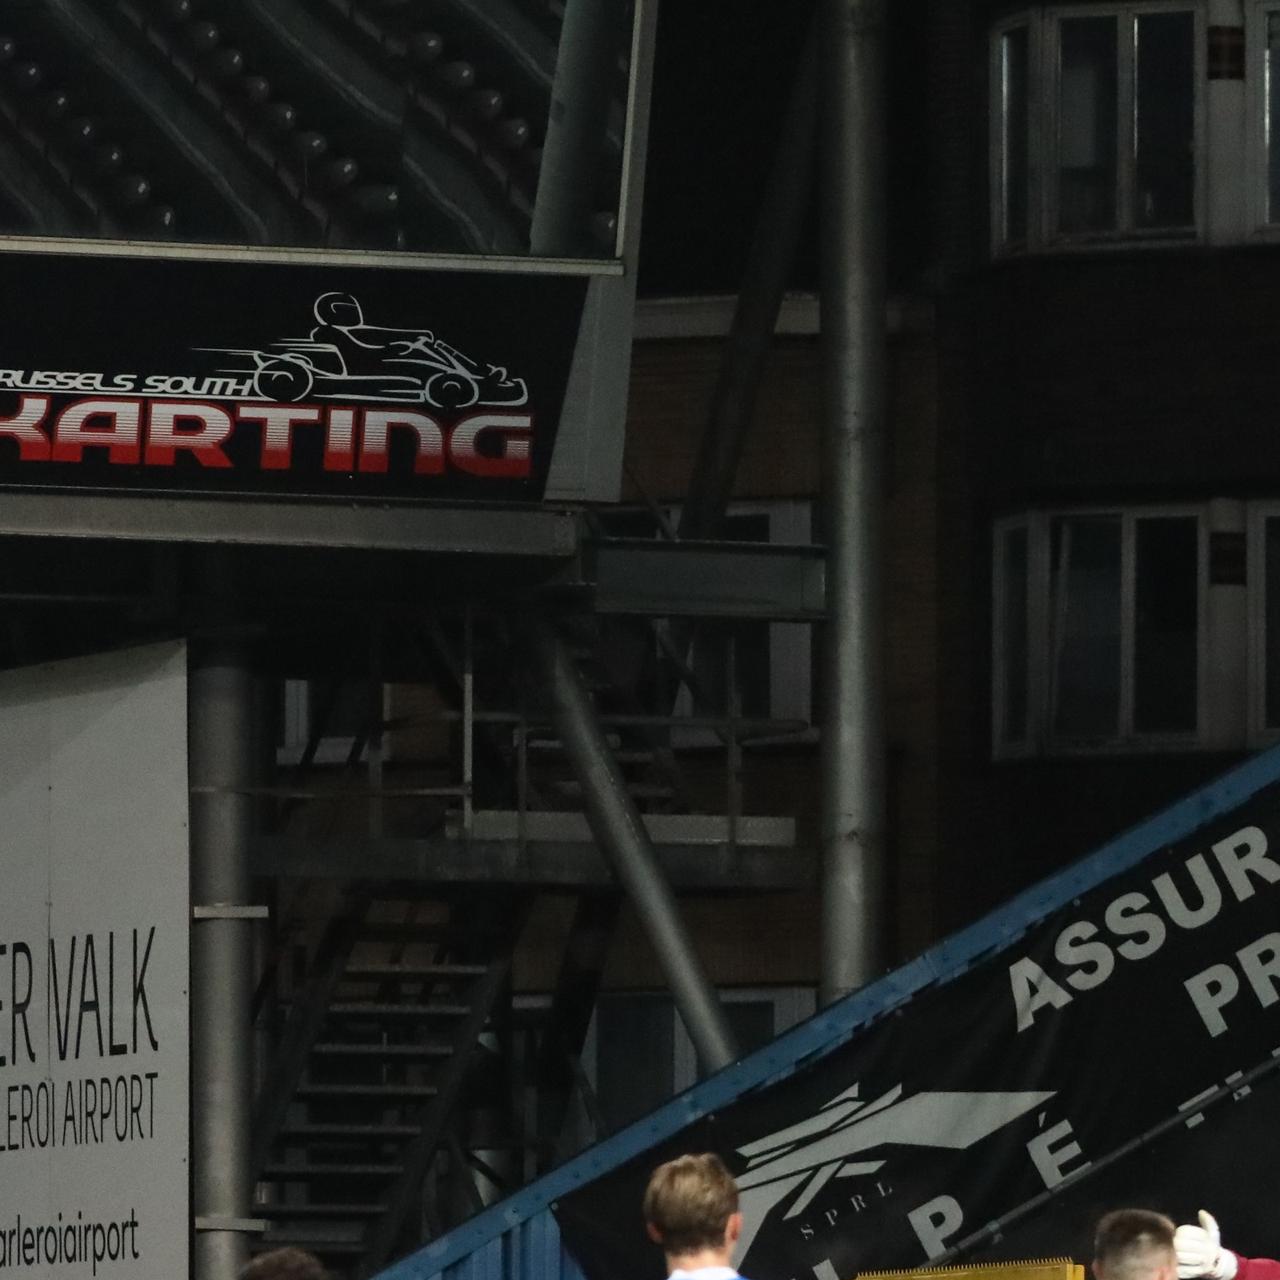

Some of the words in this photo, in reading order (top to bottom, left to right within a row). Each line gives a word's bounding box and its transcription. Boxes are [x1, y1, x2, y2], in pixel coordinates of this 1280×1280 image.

[142, 376, 254, 396] SOUTH
[50, 926, 159, 1061] VALK
[0, 1080, 56, 1151] EROI
[63, 1072, 159, 1147] AIRPORT
